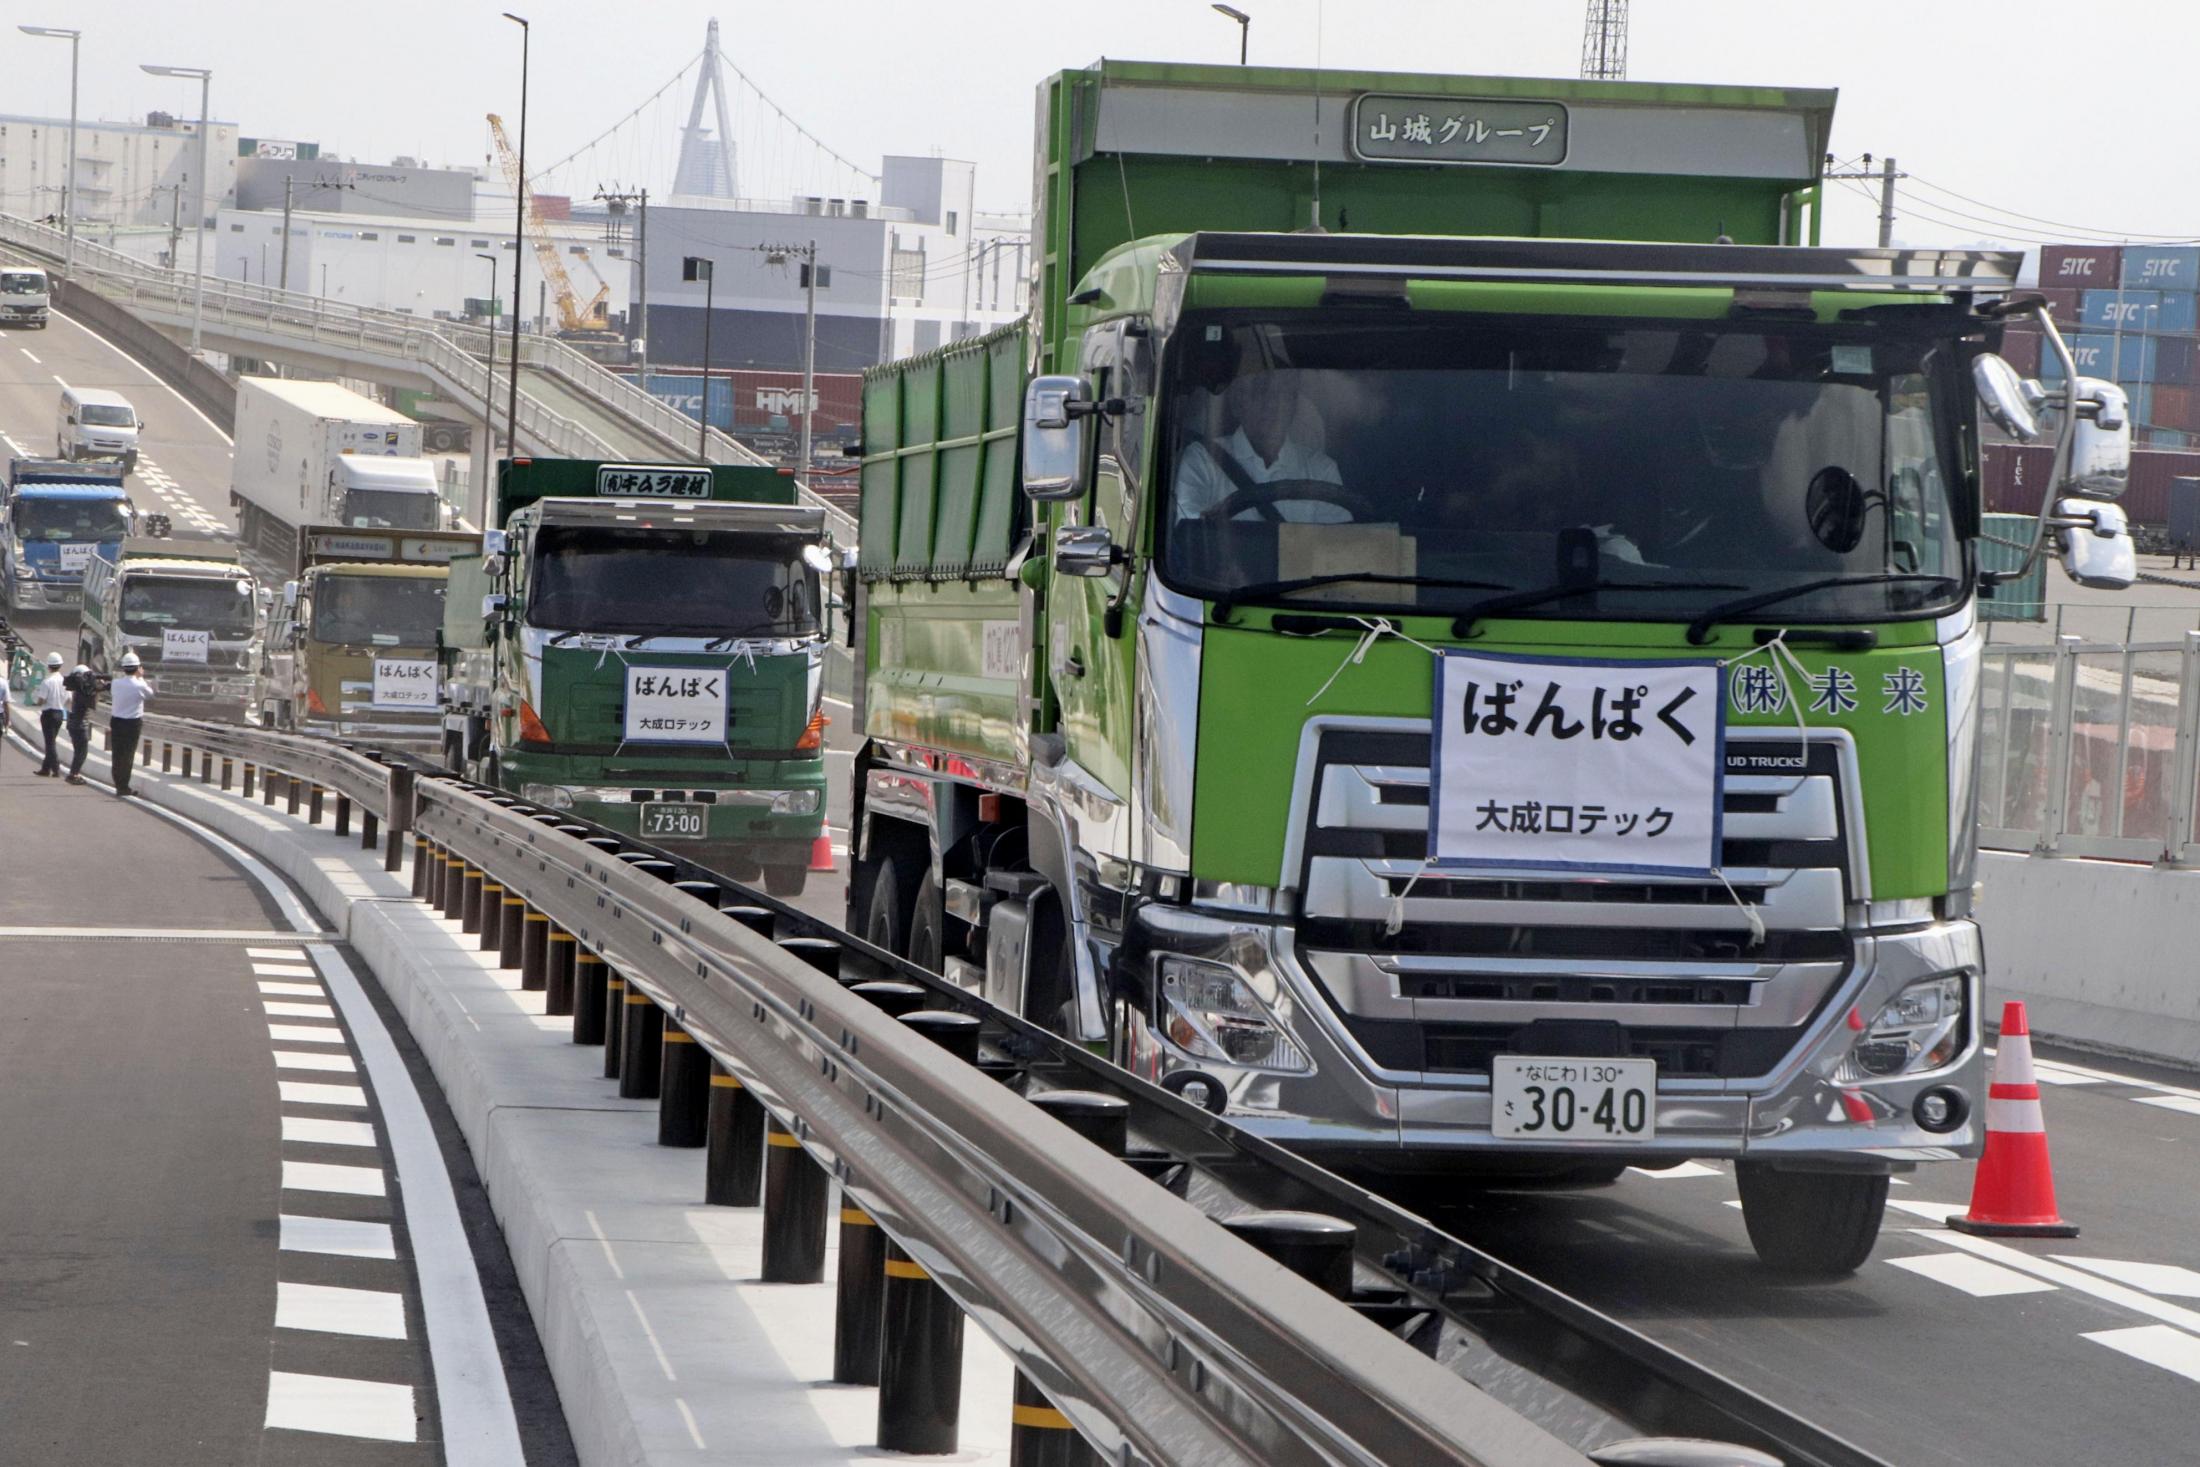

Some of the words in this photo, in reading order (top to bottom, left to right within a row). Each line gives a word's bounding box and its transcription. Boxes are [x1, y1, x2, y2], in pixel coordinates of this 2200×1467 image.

[1370, 114, 1555, 147] 山城グループ
[2059, 258, 2096, 275] SITC
[2142, 259, 2180, 276] SITC
[2102, 303, 2140, 321] SITC
[2068, 348, 2099, 366] ITC
[636, 676, 719, 698] ばんぱく
[1463, 680, 1697, 746] ばんぱく
[640, 718, 711, 731] 大成ロテック
[1727, 756, 1747, 767] UD
[1750, 756, 1803, 768] TRUCKS
[654, 814, 700, 833] 73-00
[1475, 799, 1675, 838] 大成ロテック
[1522, 1086, 1646, 1134] 30-40
